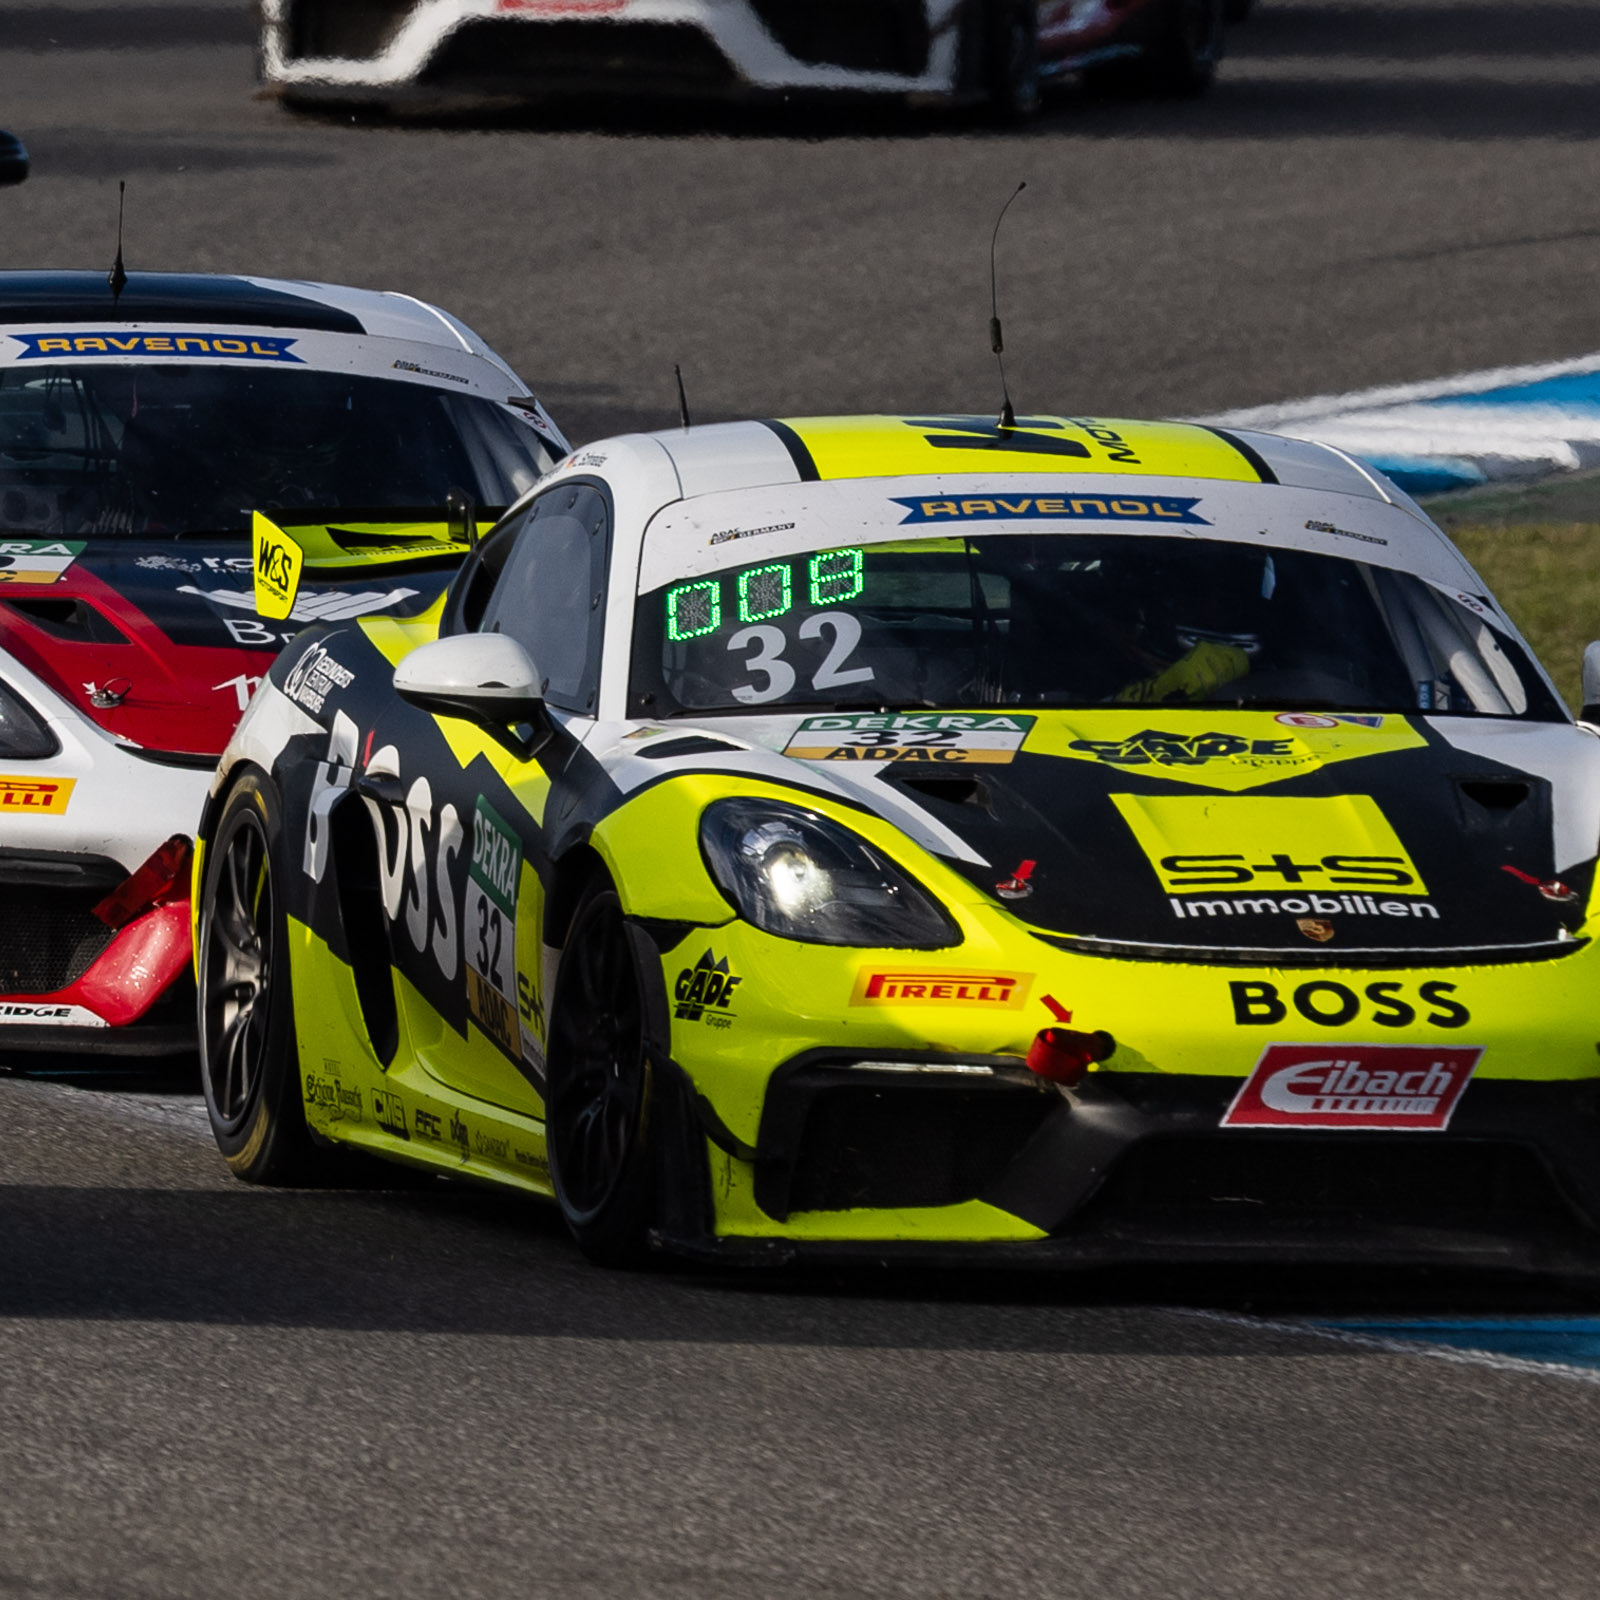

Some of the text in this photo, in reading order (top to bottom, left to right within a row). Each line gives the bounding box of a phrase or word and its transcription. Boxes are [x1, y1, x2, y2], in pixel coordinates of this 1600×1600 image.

[38, 336, 281, 357] RAVENOL
[920, 498, 1184, 518] RAVENOL
[258, 536, 293, 593] W&S
[667, 548, 864, 641] 008
[726, 610, 876, 705] 32
[802, 715, 1024, 732] DEKRA
[842, 730, 965, 748] 32
[823, 747, 970, 763] ADAC
[302, 708, 464, 981] BOSS
[473, 808, 518, 906] DEKRA
[1160, 854, 1414, 887] S+S
[1169, 893, 1441, 920] Immobilien
[476, 893, 504, 993] 32
[674, 967, 743, 1008] GADE
[864, 973, 1017, 1003] PIRELLI
[1228, 979, 1471, 1029] BOSS
[477, 975, 511, 1047] ADAC
[705, 1013, 733, 1031] Gruppe
[1260, 1059, 1455, 1116] Eibach
